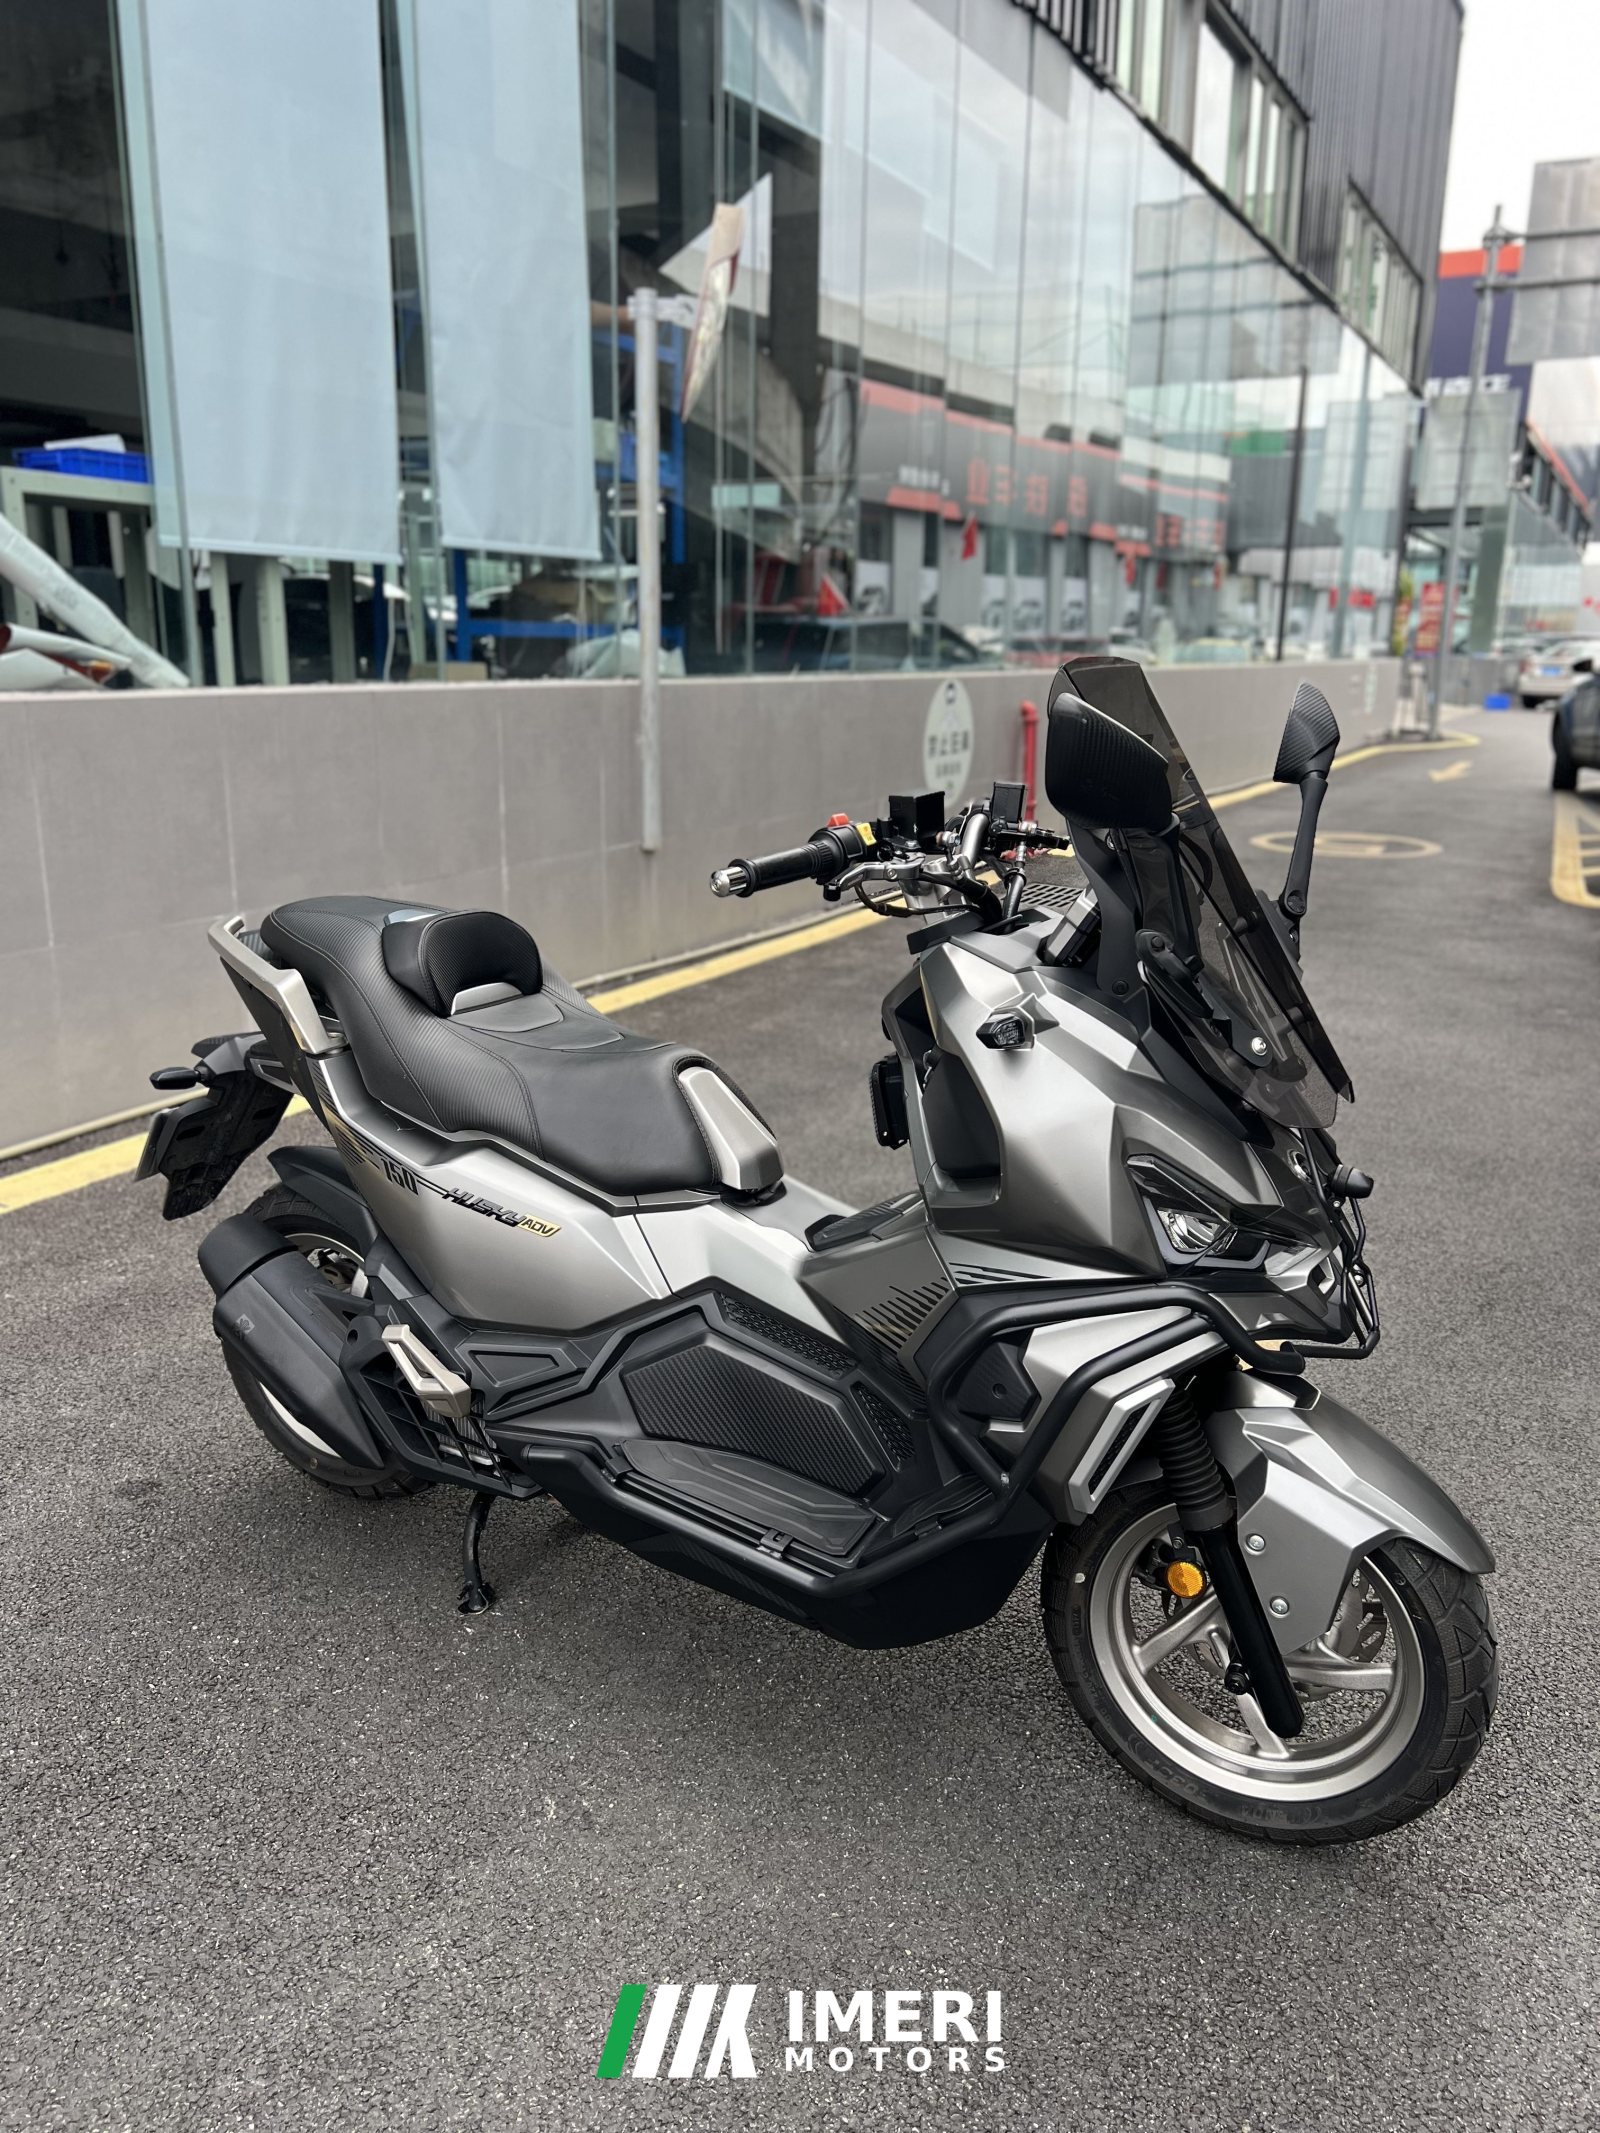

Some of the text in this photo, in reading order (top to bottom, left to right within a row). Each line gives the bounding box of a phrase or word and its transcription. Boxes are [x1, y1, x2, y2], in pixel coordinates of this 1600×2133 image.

[380, 1158, 418, 1195] 150
[442, 1188, 556, 1236] HUSKY ADV
